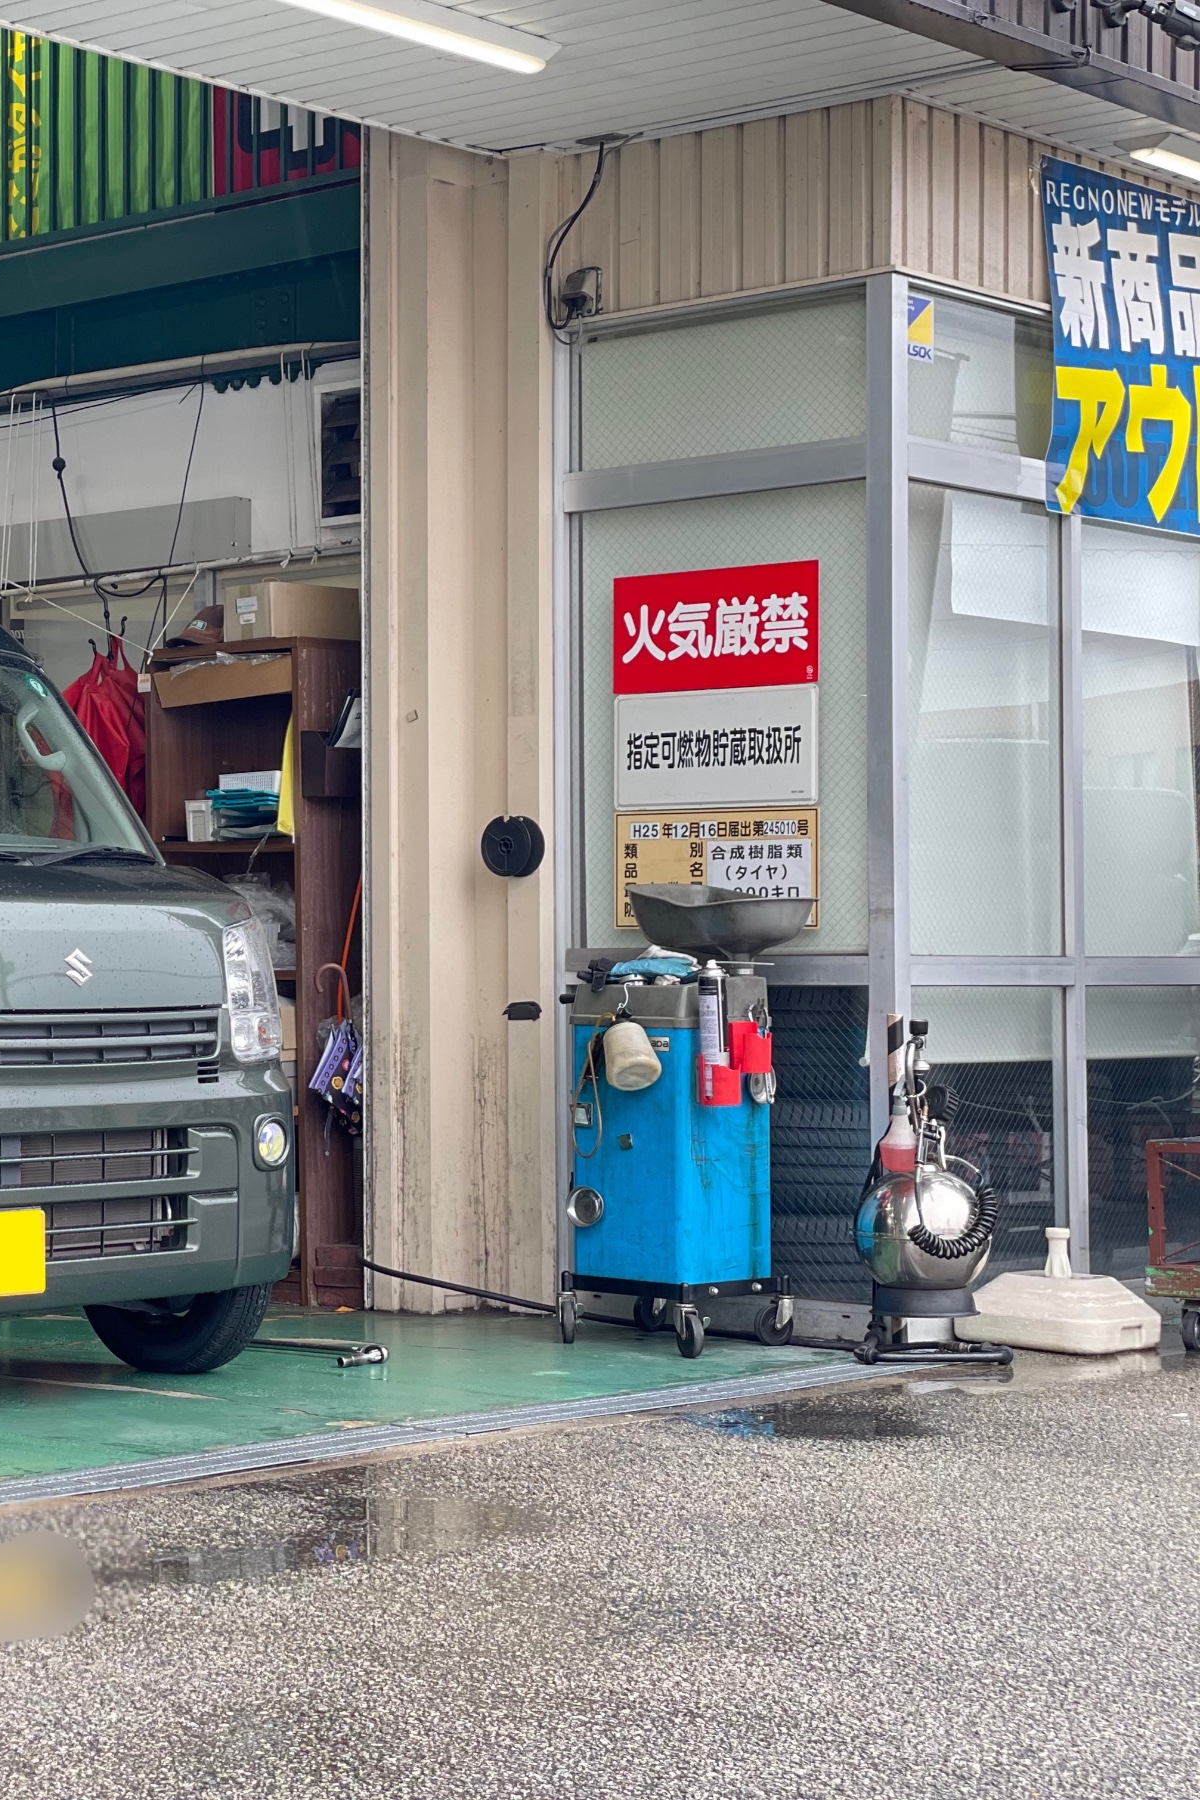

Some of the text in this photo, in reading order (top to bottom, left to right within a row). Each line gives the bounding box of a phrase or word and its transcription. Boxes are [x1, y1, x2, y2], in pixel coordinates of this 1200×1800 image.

[622, 592, 809, 663] 火気厳禁
[626, 724, 802, 770] 指定可燃物貯蔵取扱所
[711, 844, 803, 861] 合成樹脂類
